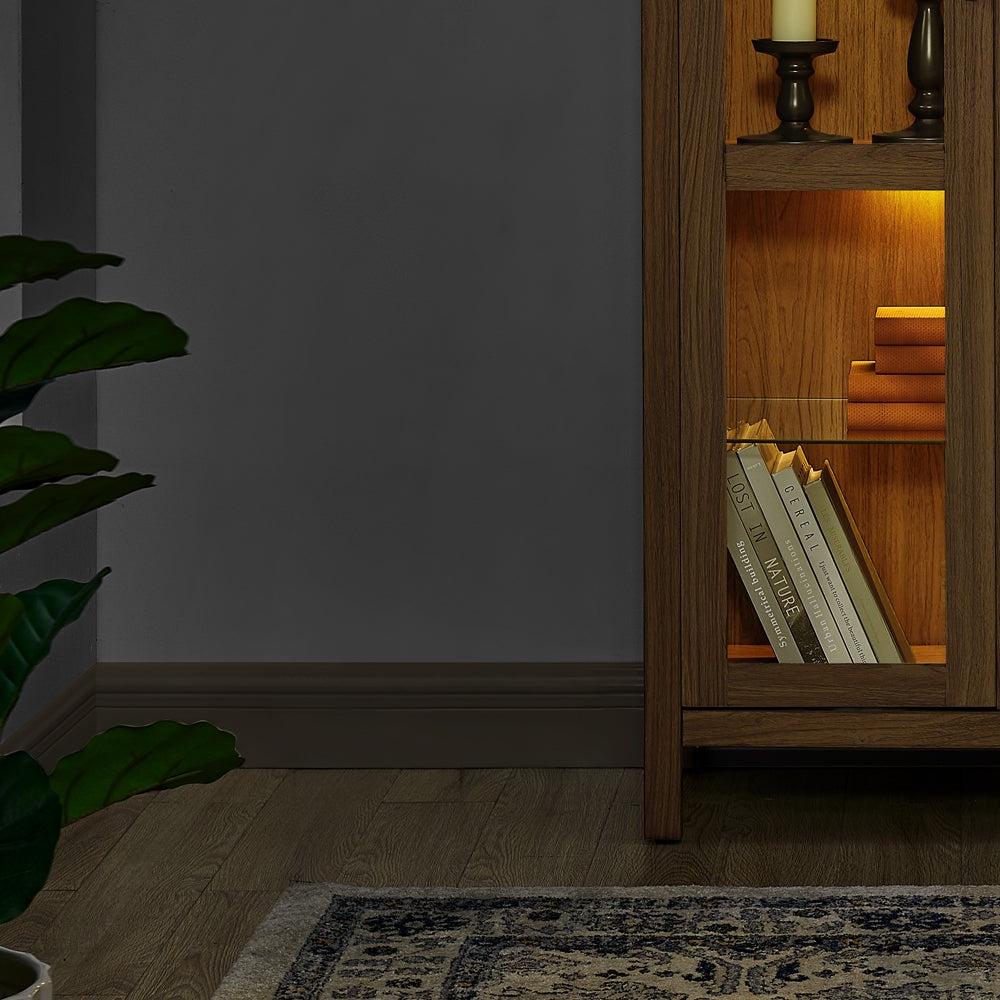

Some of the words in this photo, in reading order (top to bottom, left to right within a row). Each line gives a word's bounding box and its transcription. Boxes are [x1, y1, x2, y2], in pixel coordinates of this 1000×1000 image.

[727, 474, 755, 512] LOST
[749, 524, 767, 544] IN
[765, 558, 799, 617] NATURE
[784, 485, 819, 552] CEREAL
[736, 541, 759, 586] building
[785, 540, 822, 620] Hallucinations
[755, 585, 787, 648] Symmetrical
[819, 619, 837, 652] Urban
[825, 575, 836, 592] want
[835, 597, 847, 617] collect
[847, 626, 863, 653] beautiful
